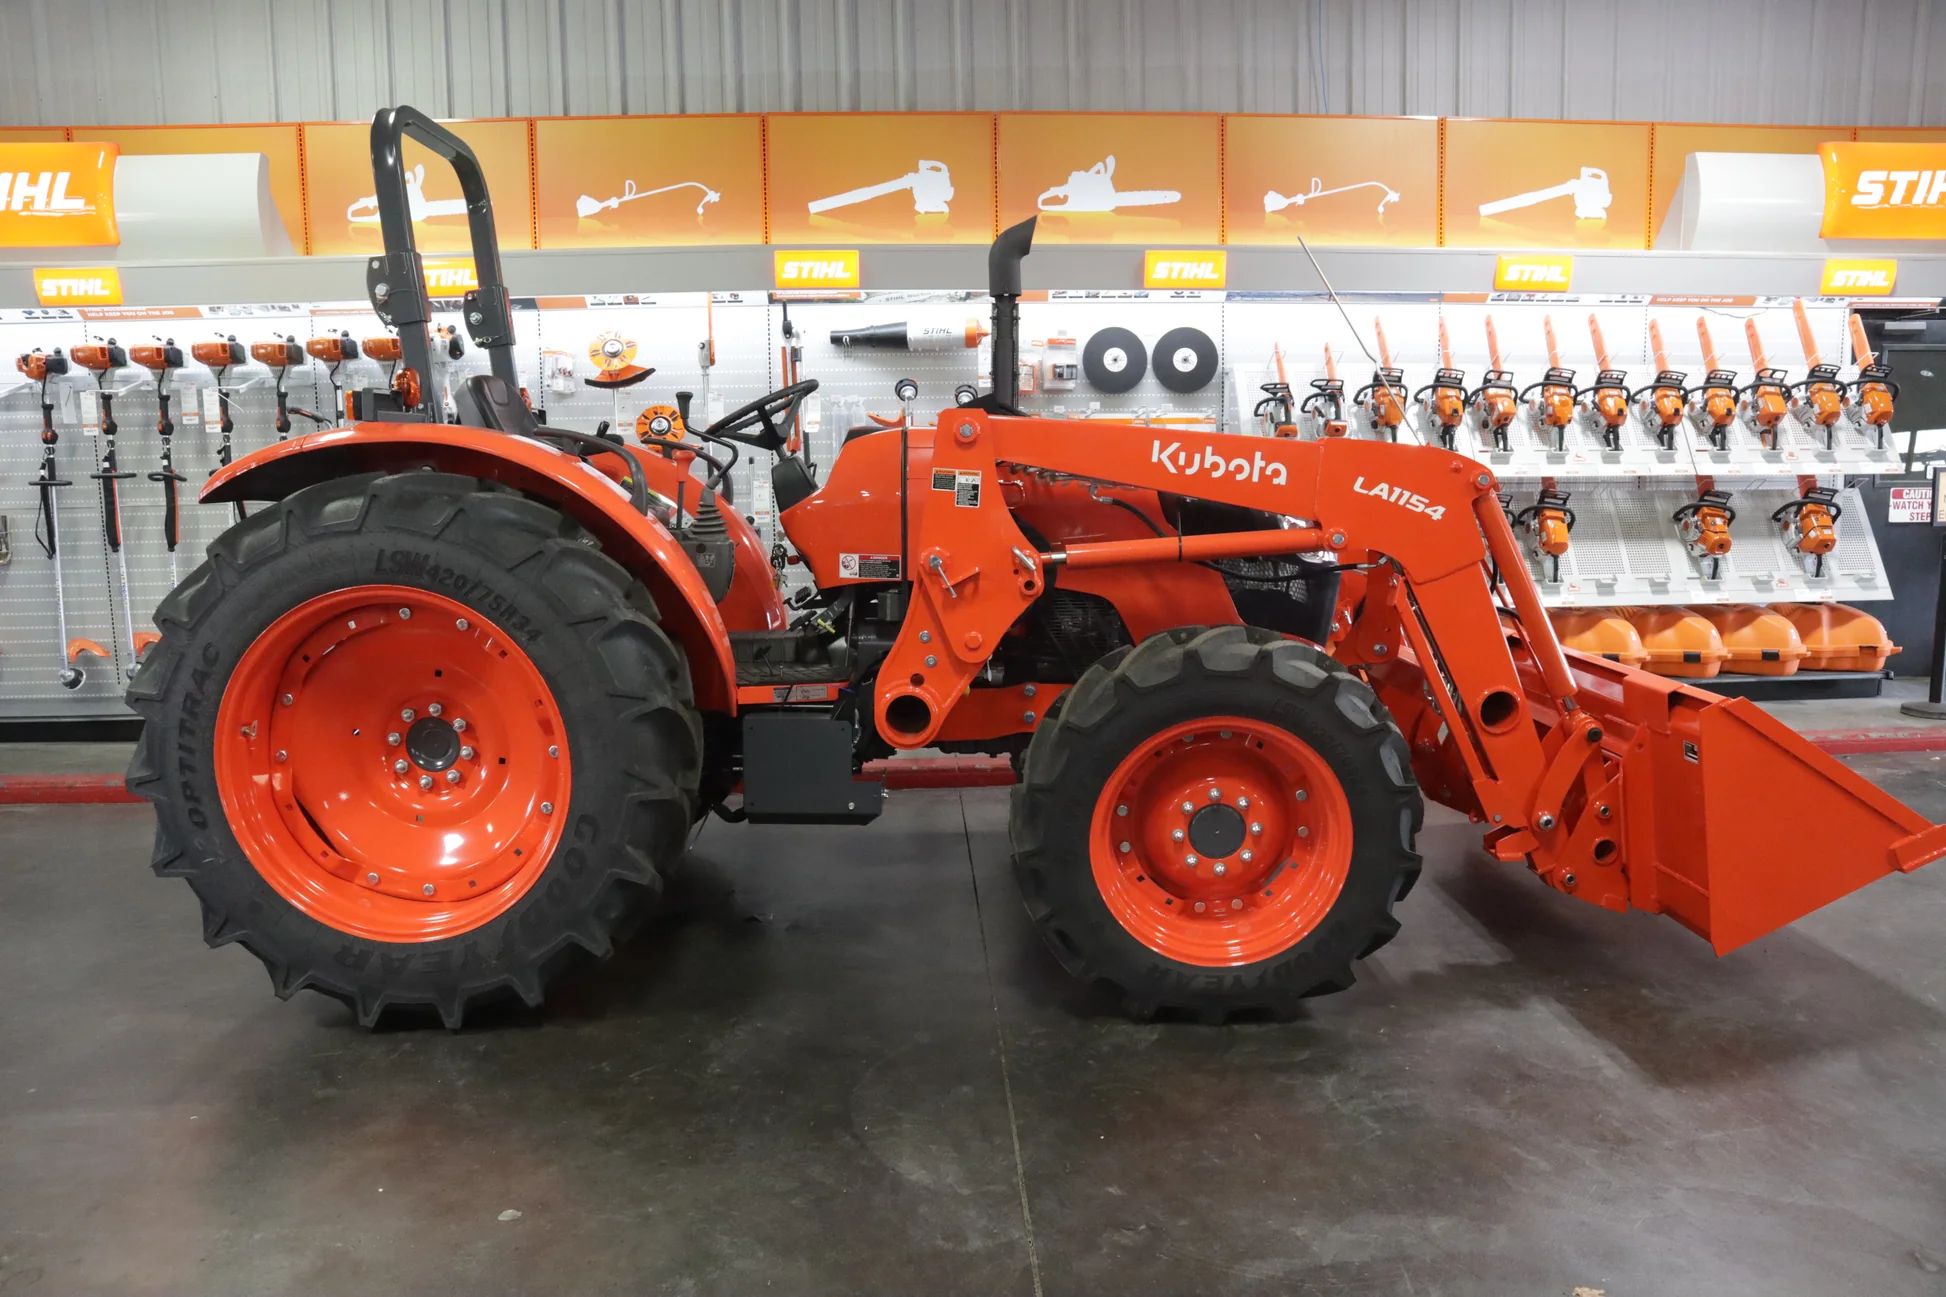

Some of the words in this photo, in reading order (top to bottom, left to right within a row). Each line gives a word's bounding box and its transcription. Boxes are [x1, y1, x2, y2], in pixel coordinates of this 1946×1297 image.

[0, 172, 86, 211] IHL
[423, 268, 478, 286] TIHL
[782, 261, 850, 279] STIHL
[1152, 262, 1219, 279] STIHL
[1504, 264, 1566, 282] STIHL
[1830, 270, 1890, 287] STIHL
[42, 278, 110, 296] STIHL
[923, 327, 952, 335] STIHL
[1151, 440, 1288, 486] Kubota
[1353, 476, 1446, 521] LA1154
[1903, 489, 1932, 499] CAUTI
[1892, 501, 1924, 510] WATCH
[178, 641, 221, 831] OPTITRAC
